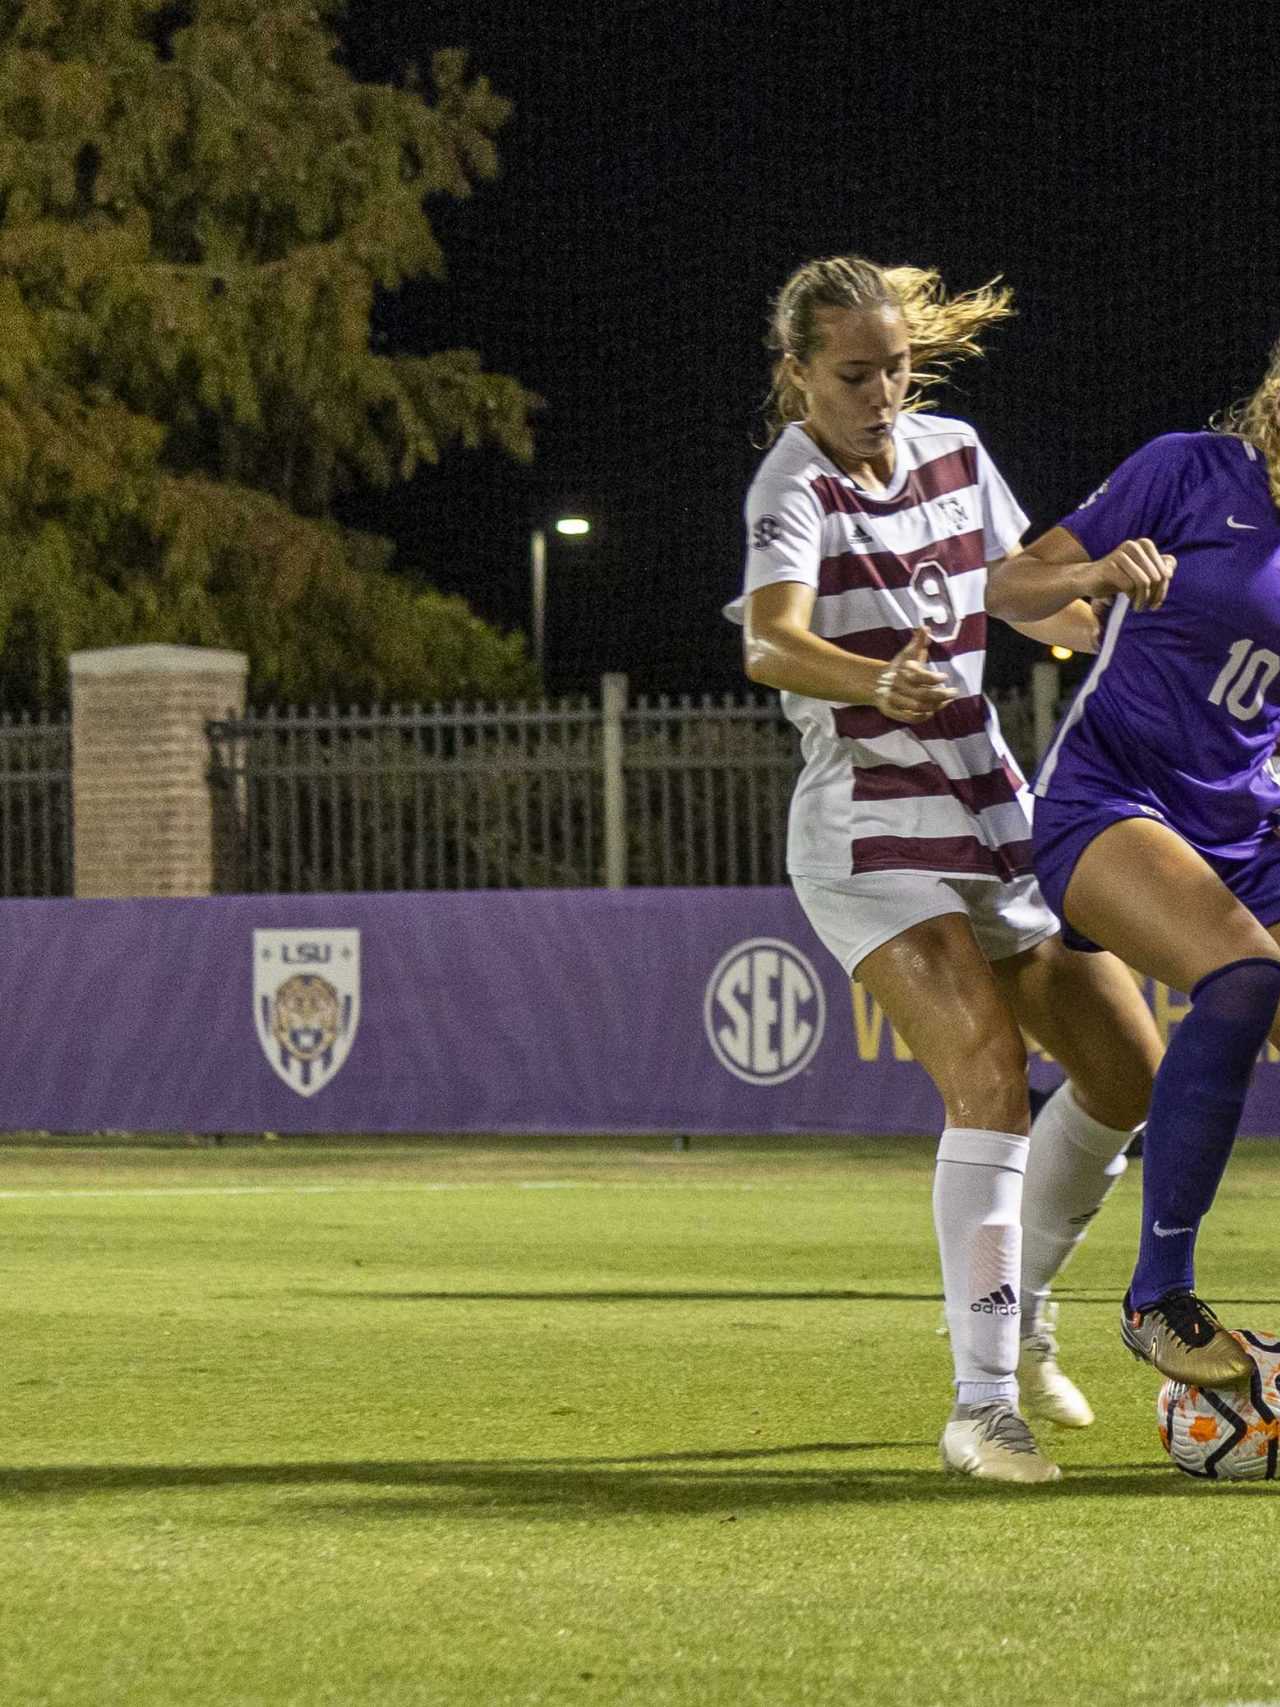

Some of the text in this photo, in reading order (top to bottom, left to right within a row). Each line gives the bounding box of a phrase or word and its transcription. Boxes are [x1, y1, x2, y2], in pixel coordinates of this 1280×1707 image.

[909, 560, 962, 642] 9
[1207, 638, 1280, 722] 10
[281, 943, 332, 965] LSU
[716, 950, 814, 1074] SEC
